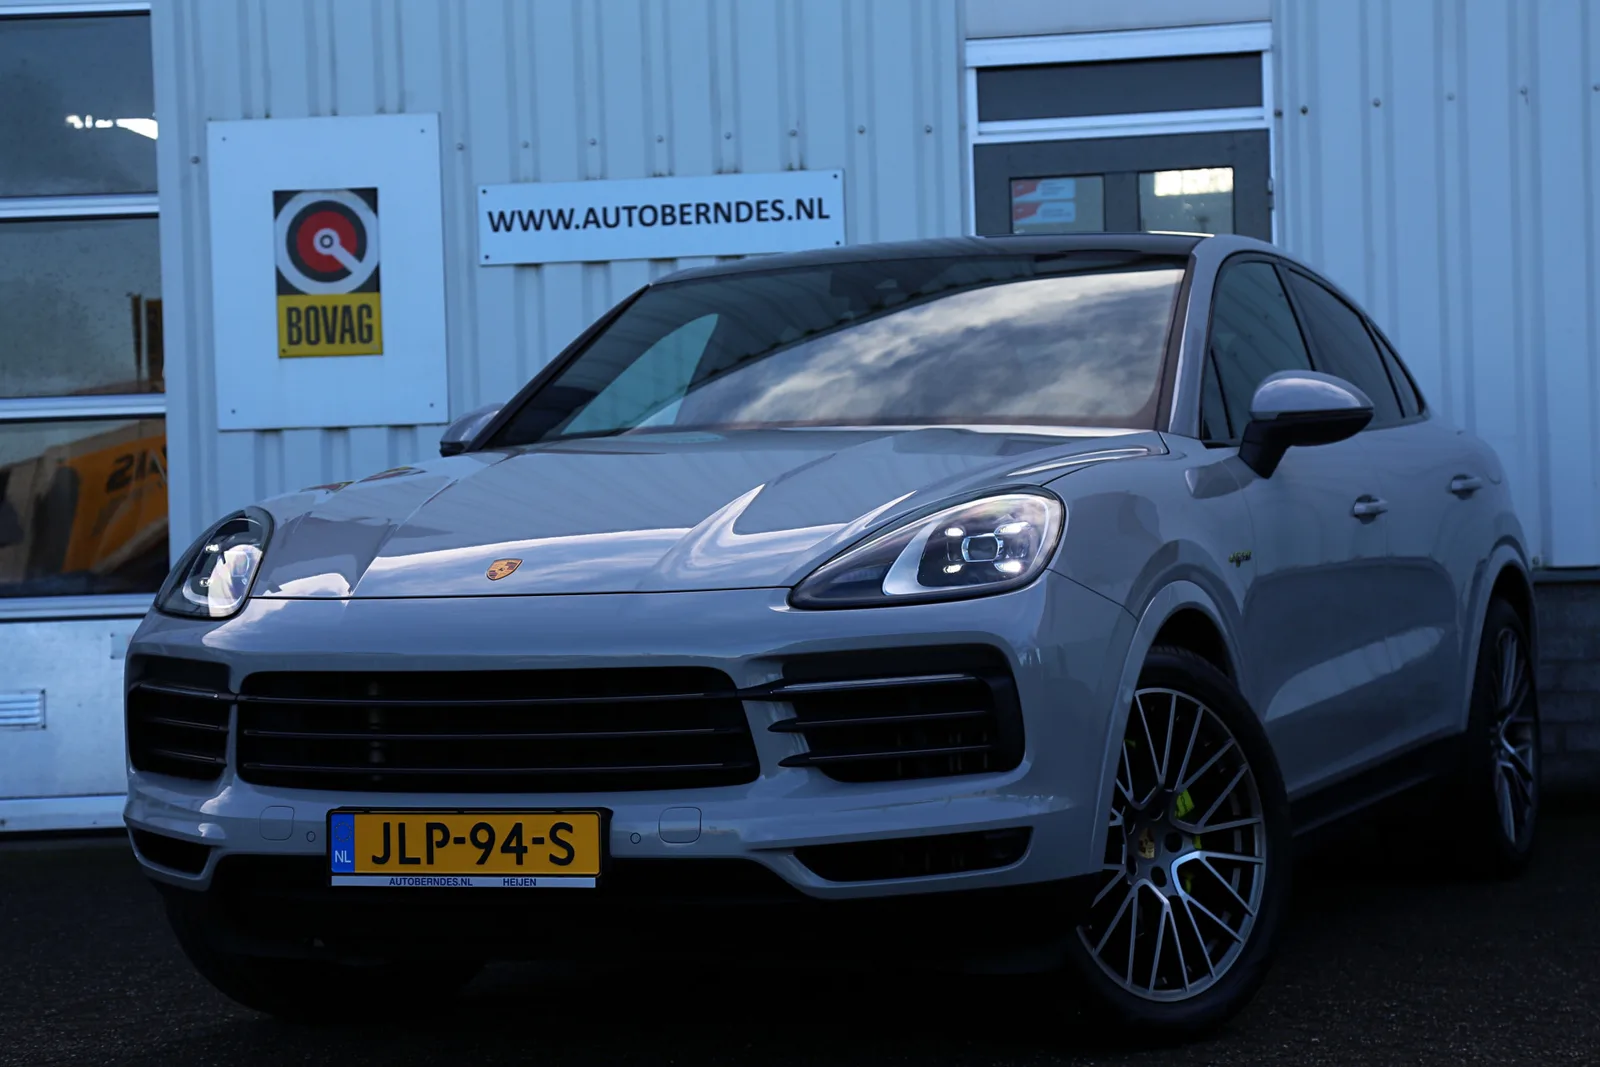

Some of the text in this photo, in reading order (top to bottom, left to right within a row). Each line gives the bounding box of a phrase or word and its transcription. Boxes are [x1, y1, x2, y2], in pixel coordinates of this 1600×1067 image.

[488, 197, 830, 233] WWW.AUTOBERNDES.NL
[286, 304, 373, 346] BOVAG
[334, 850, 351, 863] NL
[371, 821, 575, 866] JLP-94-S
[389, 877, 537, 887] AUTOBERNDES.NL HEIJEN
